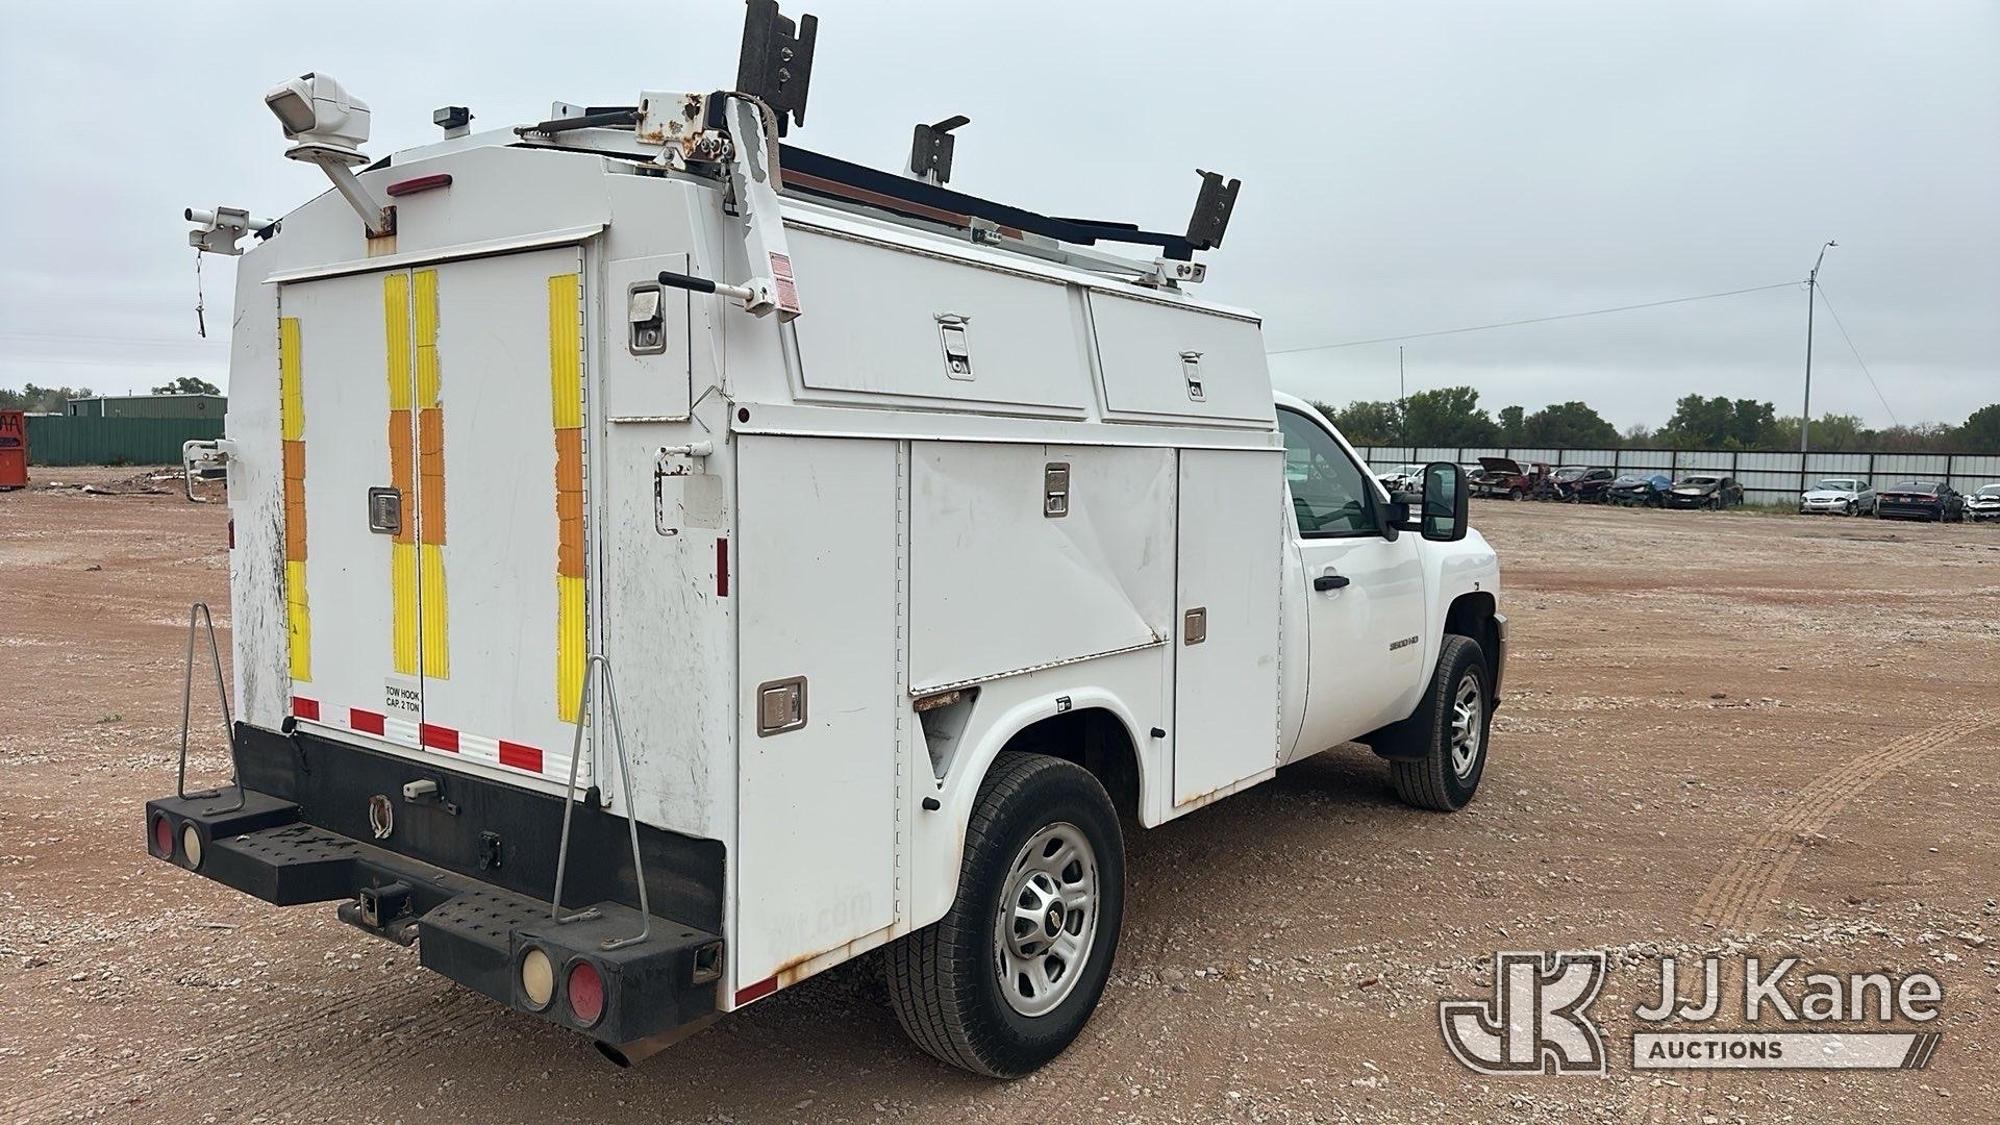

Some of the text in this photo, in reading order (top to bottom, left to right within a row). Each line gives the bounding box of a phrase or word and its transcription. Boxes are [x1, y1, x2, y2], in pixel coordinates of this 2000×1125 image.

[385, 685, 420, 701] TOW HOOK
[386, 697, 420, 712] CAP. 2 TON
